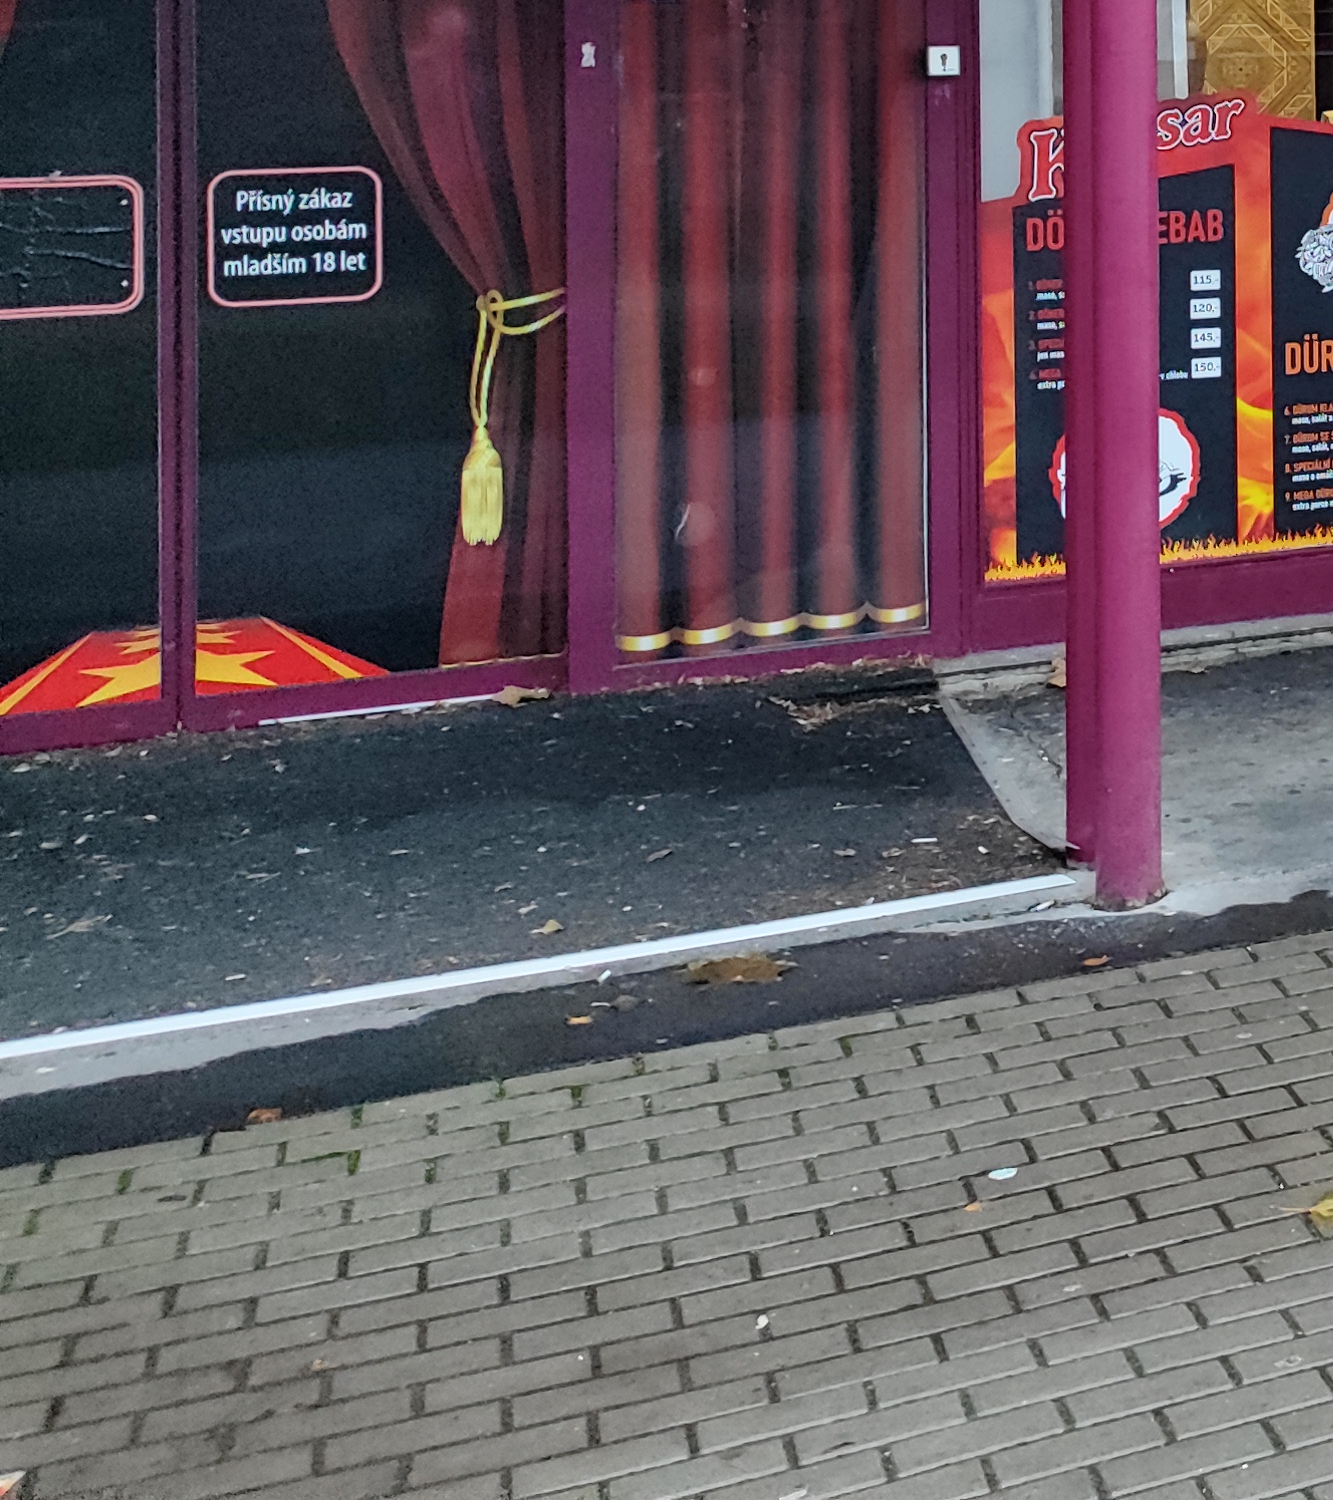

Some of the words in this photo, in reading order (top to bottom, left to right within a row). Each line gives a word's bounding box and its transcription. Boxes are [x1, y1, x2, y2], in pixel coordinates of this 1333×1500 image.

[236, 188, 295, 217] Přísný
[298, 187, 353, 210] zákaz
[221, 225, 287, 248] vstupu
[291, 218, 367, 242] osobám
[1158, 208, 1224, 246] EBAB
[223, 252, 307, 277] mladším
[312, 252, 336, 273] 18
[340, 250, 367, 272] let
